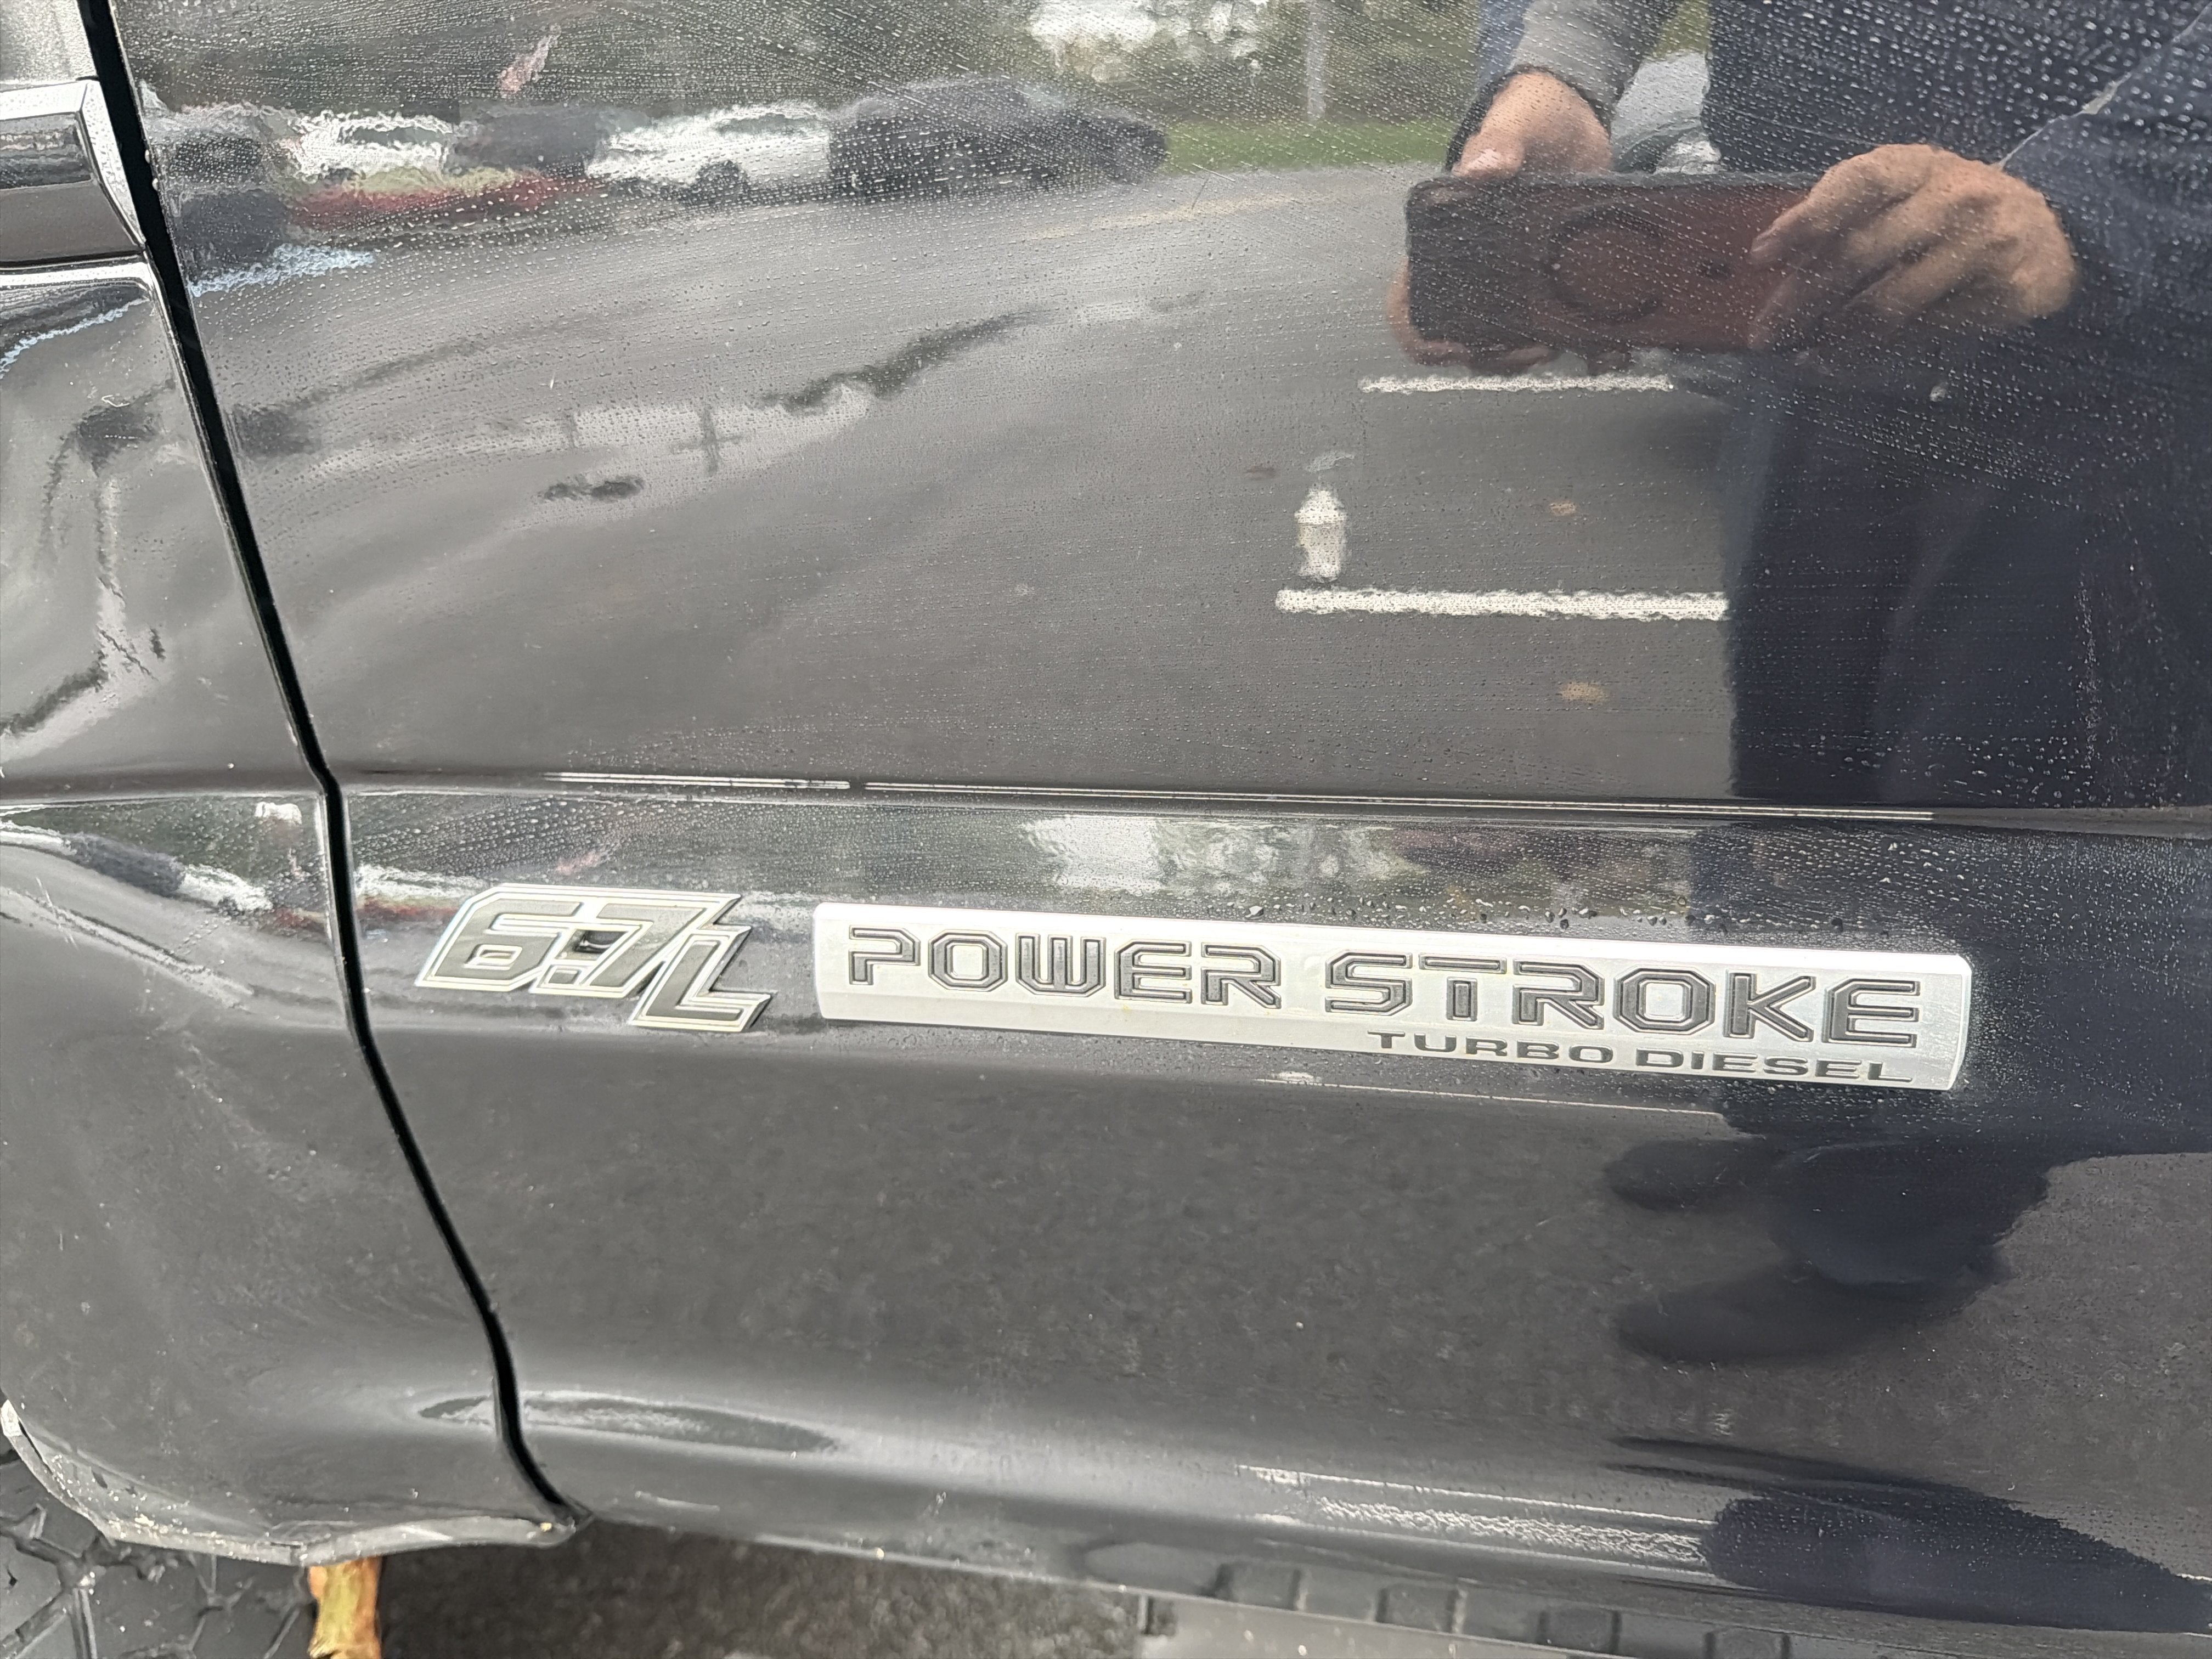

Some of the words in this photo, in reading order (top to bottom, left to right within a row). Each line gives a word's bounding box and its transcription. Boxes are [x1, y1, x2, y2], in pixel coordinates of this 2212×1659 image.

[415, 883, 770, 1031] 6.7L
[849, 925, 1282, 1009] POWER
[1325, 949, 1921, 1048] STROKE
[1367, 1031, 1613, 1064] TURBO
[1643, 1049, 1912, 1083] DIESEL
